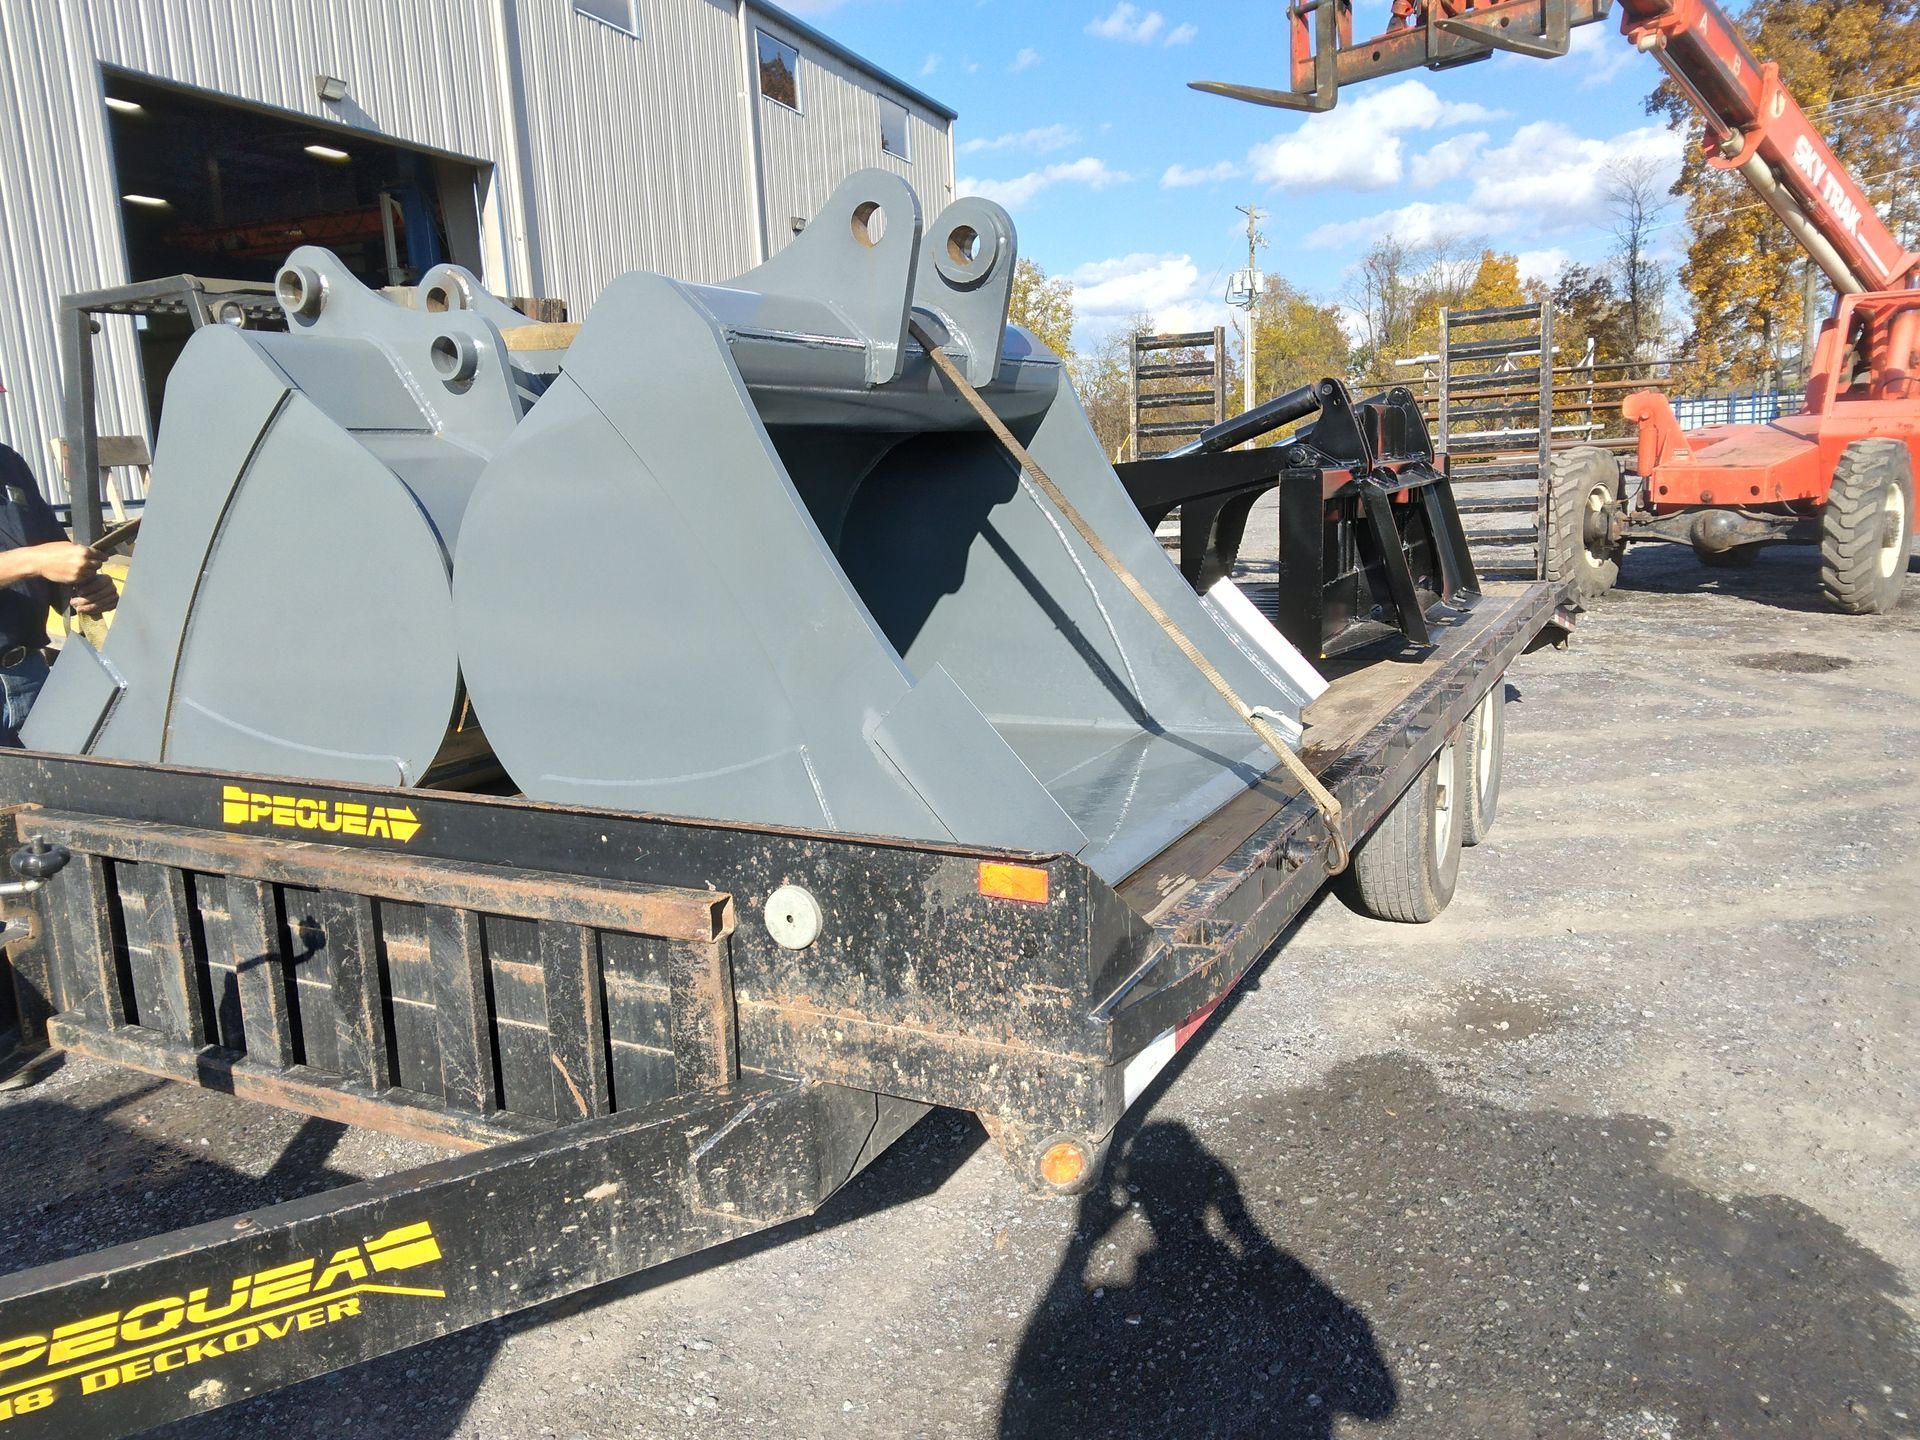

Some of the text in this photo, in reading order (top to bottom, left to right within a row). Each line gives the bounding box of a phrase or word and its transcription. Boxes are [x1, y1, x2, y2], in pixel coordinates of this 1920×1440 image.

[1793, 134, 1862, 236] SKY TRAK
[250, 793, 390, 839] PEQUEA
[80, 1298, 362, 1395] DECKOVER
